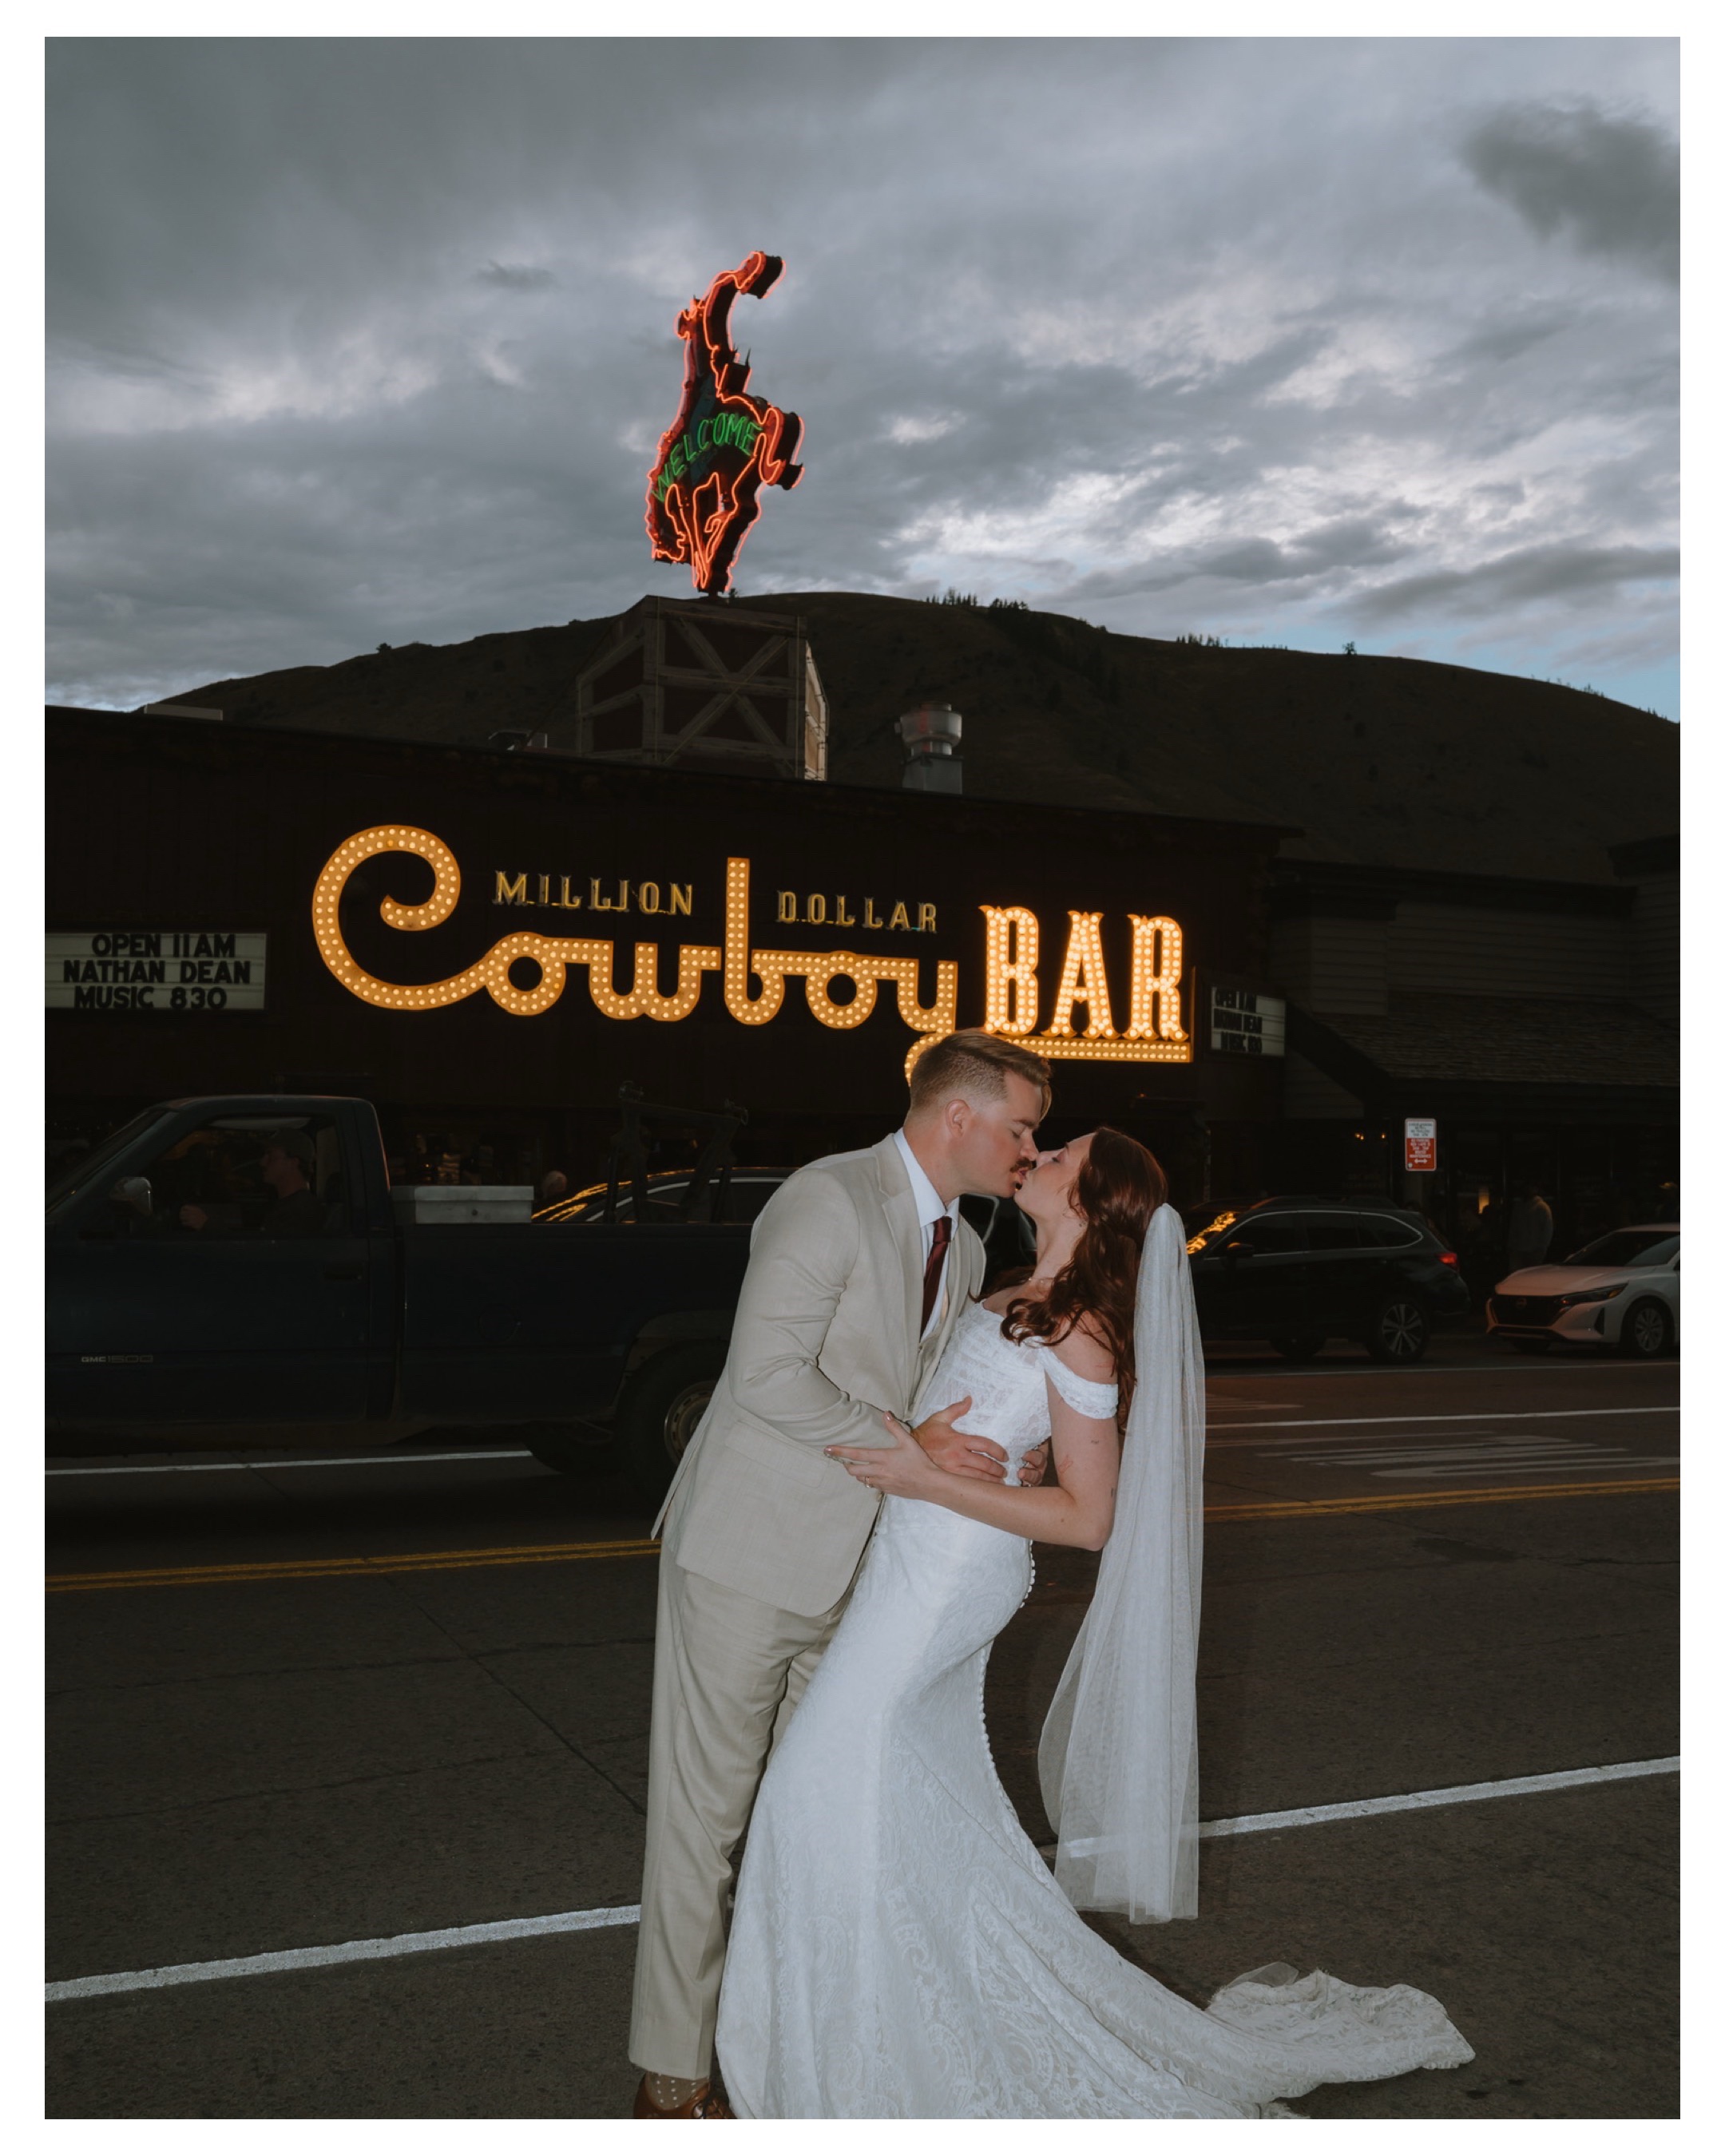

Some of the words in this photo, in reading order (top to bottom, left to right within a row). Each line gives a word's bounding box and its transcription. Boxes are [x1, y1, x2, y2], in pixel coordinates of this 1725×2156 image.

[652, 412, 763, 502] WELCOME
[492, 870, 694, 917] MILLION
[776, 890, 938, 933] DOLLAR
[92, 933, 161, 957] OPEN
[312, 825, 958, 1088] Cowboy
[978, 905, 1189, 1040] BAR
[64, 961, 165, 983] NATHAN
[180, 961, 250, 984] DEAN
[74, 986, 154, 1009] MUSIC
[170, 987, 227, 1009] 830
